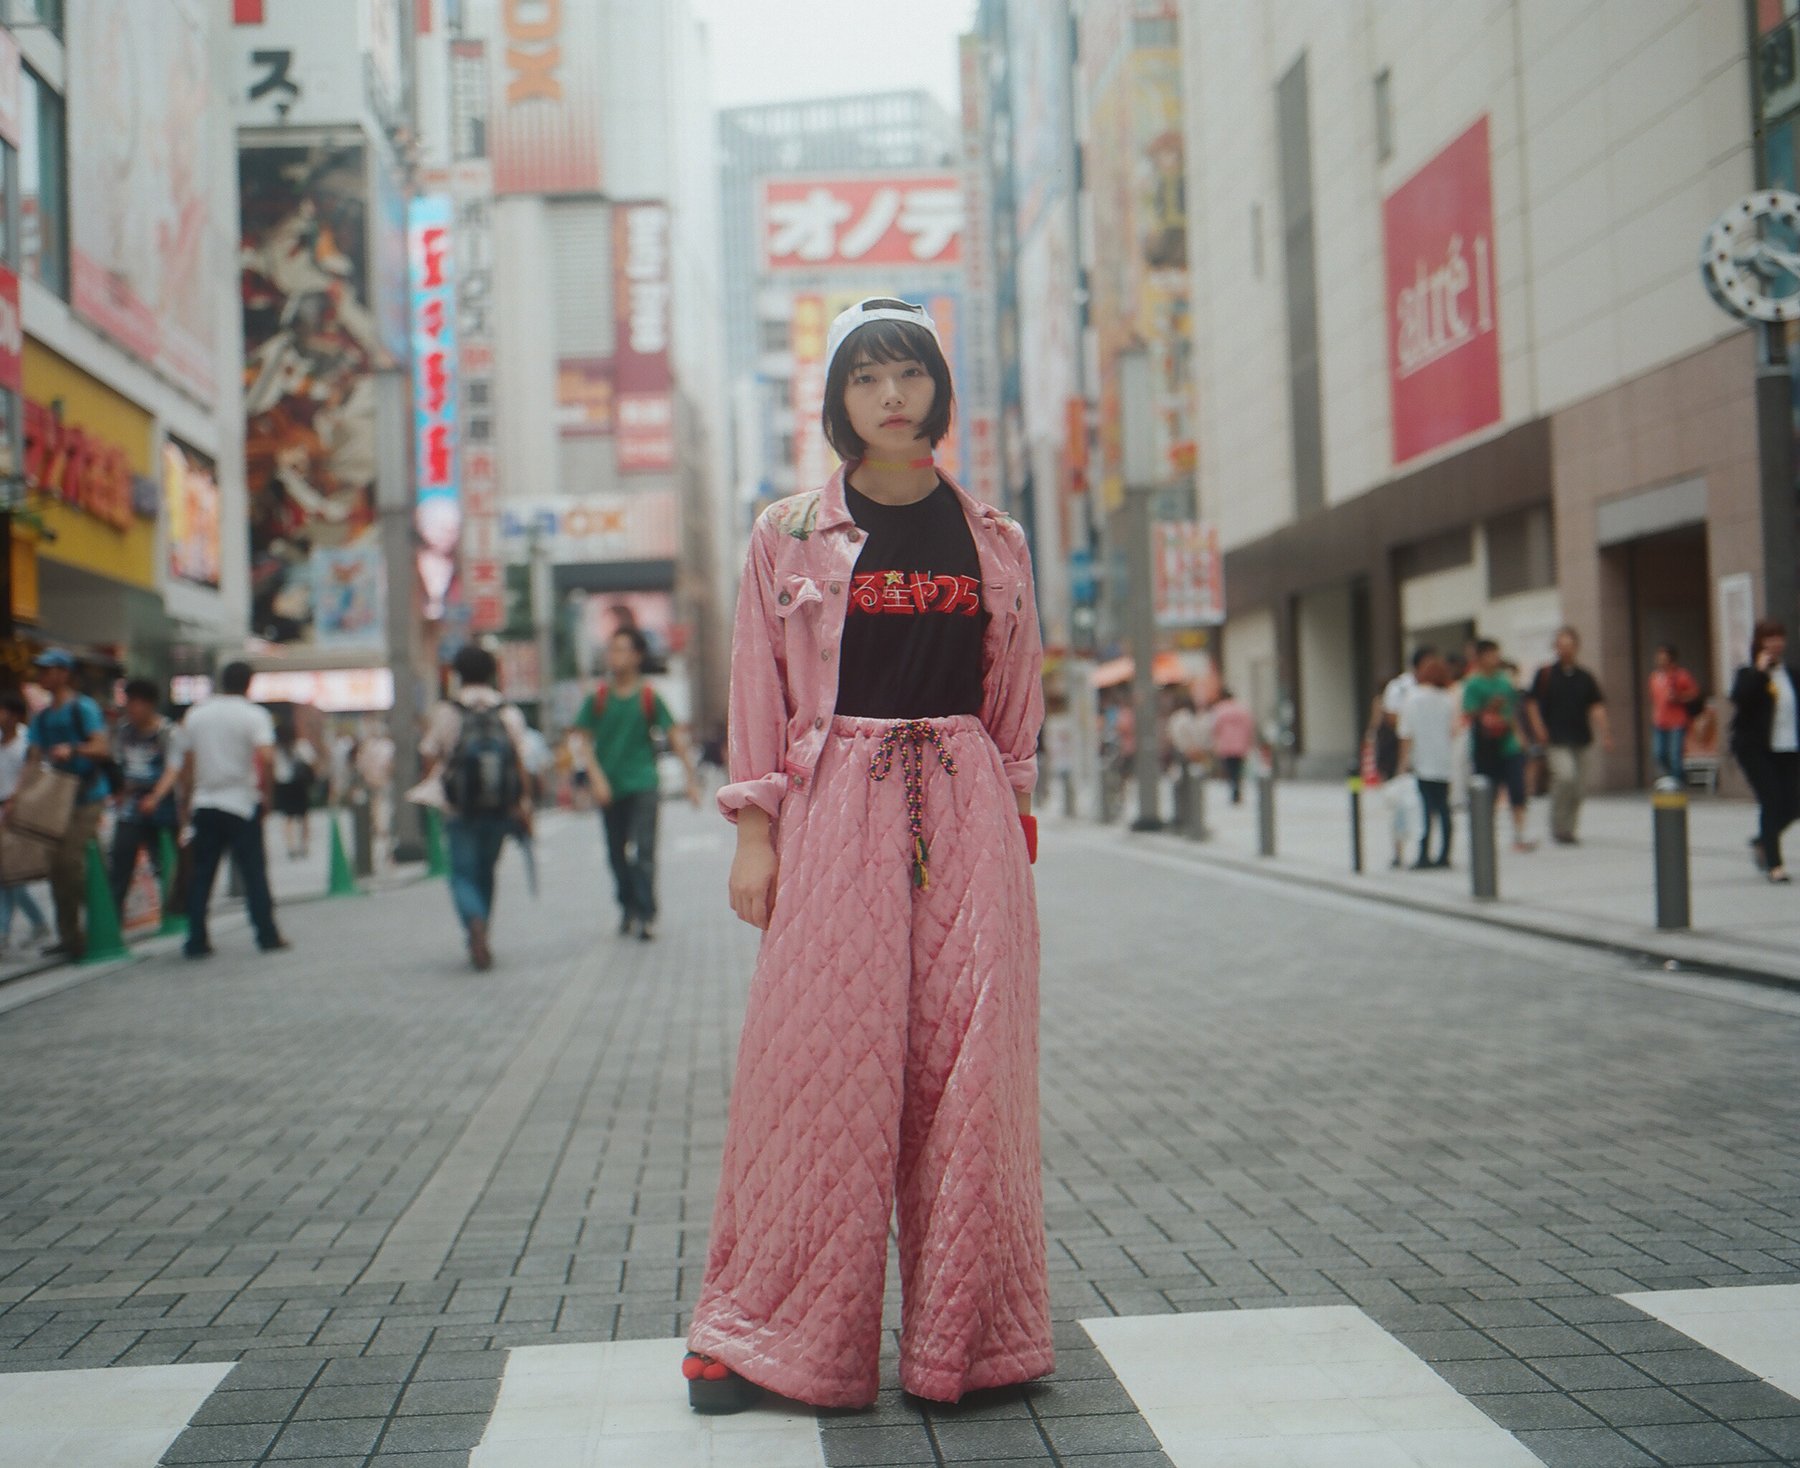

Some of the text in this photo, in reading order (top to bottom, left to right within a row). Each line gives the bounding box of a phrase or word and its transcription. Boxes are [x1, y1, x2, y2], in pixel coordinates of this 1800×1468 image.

[848, 569, 982, 617] る星やつら
